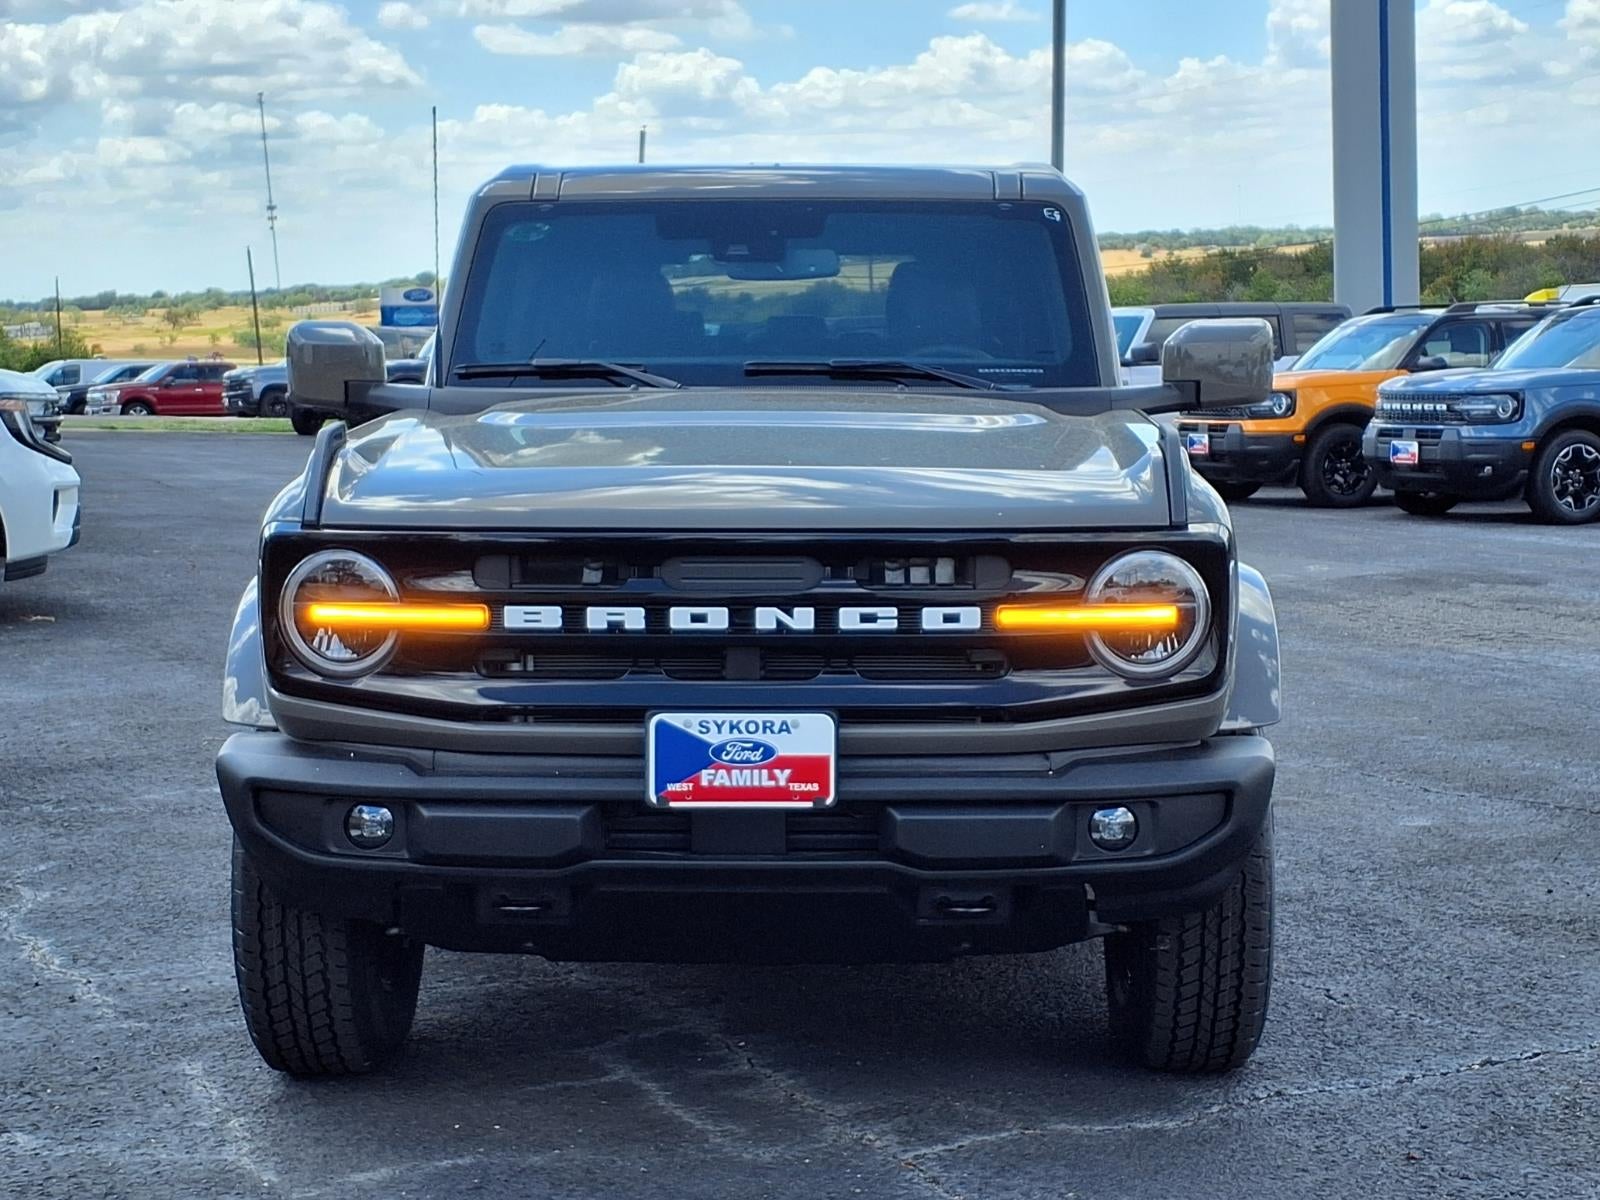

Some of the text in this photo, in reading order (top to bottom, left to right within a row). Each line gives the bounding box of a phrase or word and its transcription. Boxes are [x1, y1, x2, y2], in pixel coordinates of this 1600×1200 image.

[503, 605, 982, 630] BRONCO
[698, 719, 792, 735] SYKORA
[721, 741, 763, 761] Ford
[666, 782, 819, 791] WEST TEXAS
[701, 768, 791, 787] FAMILY
